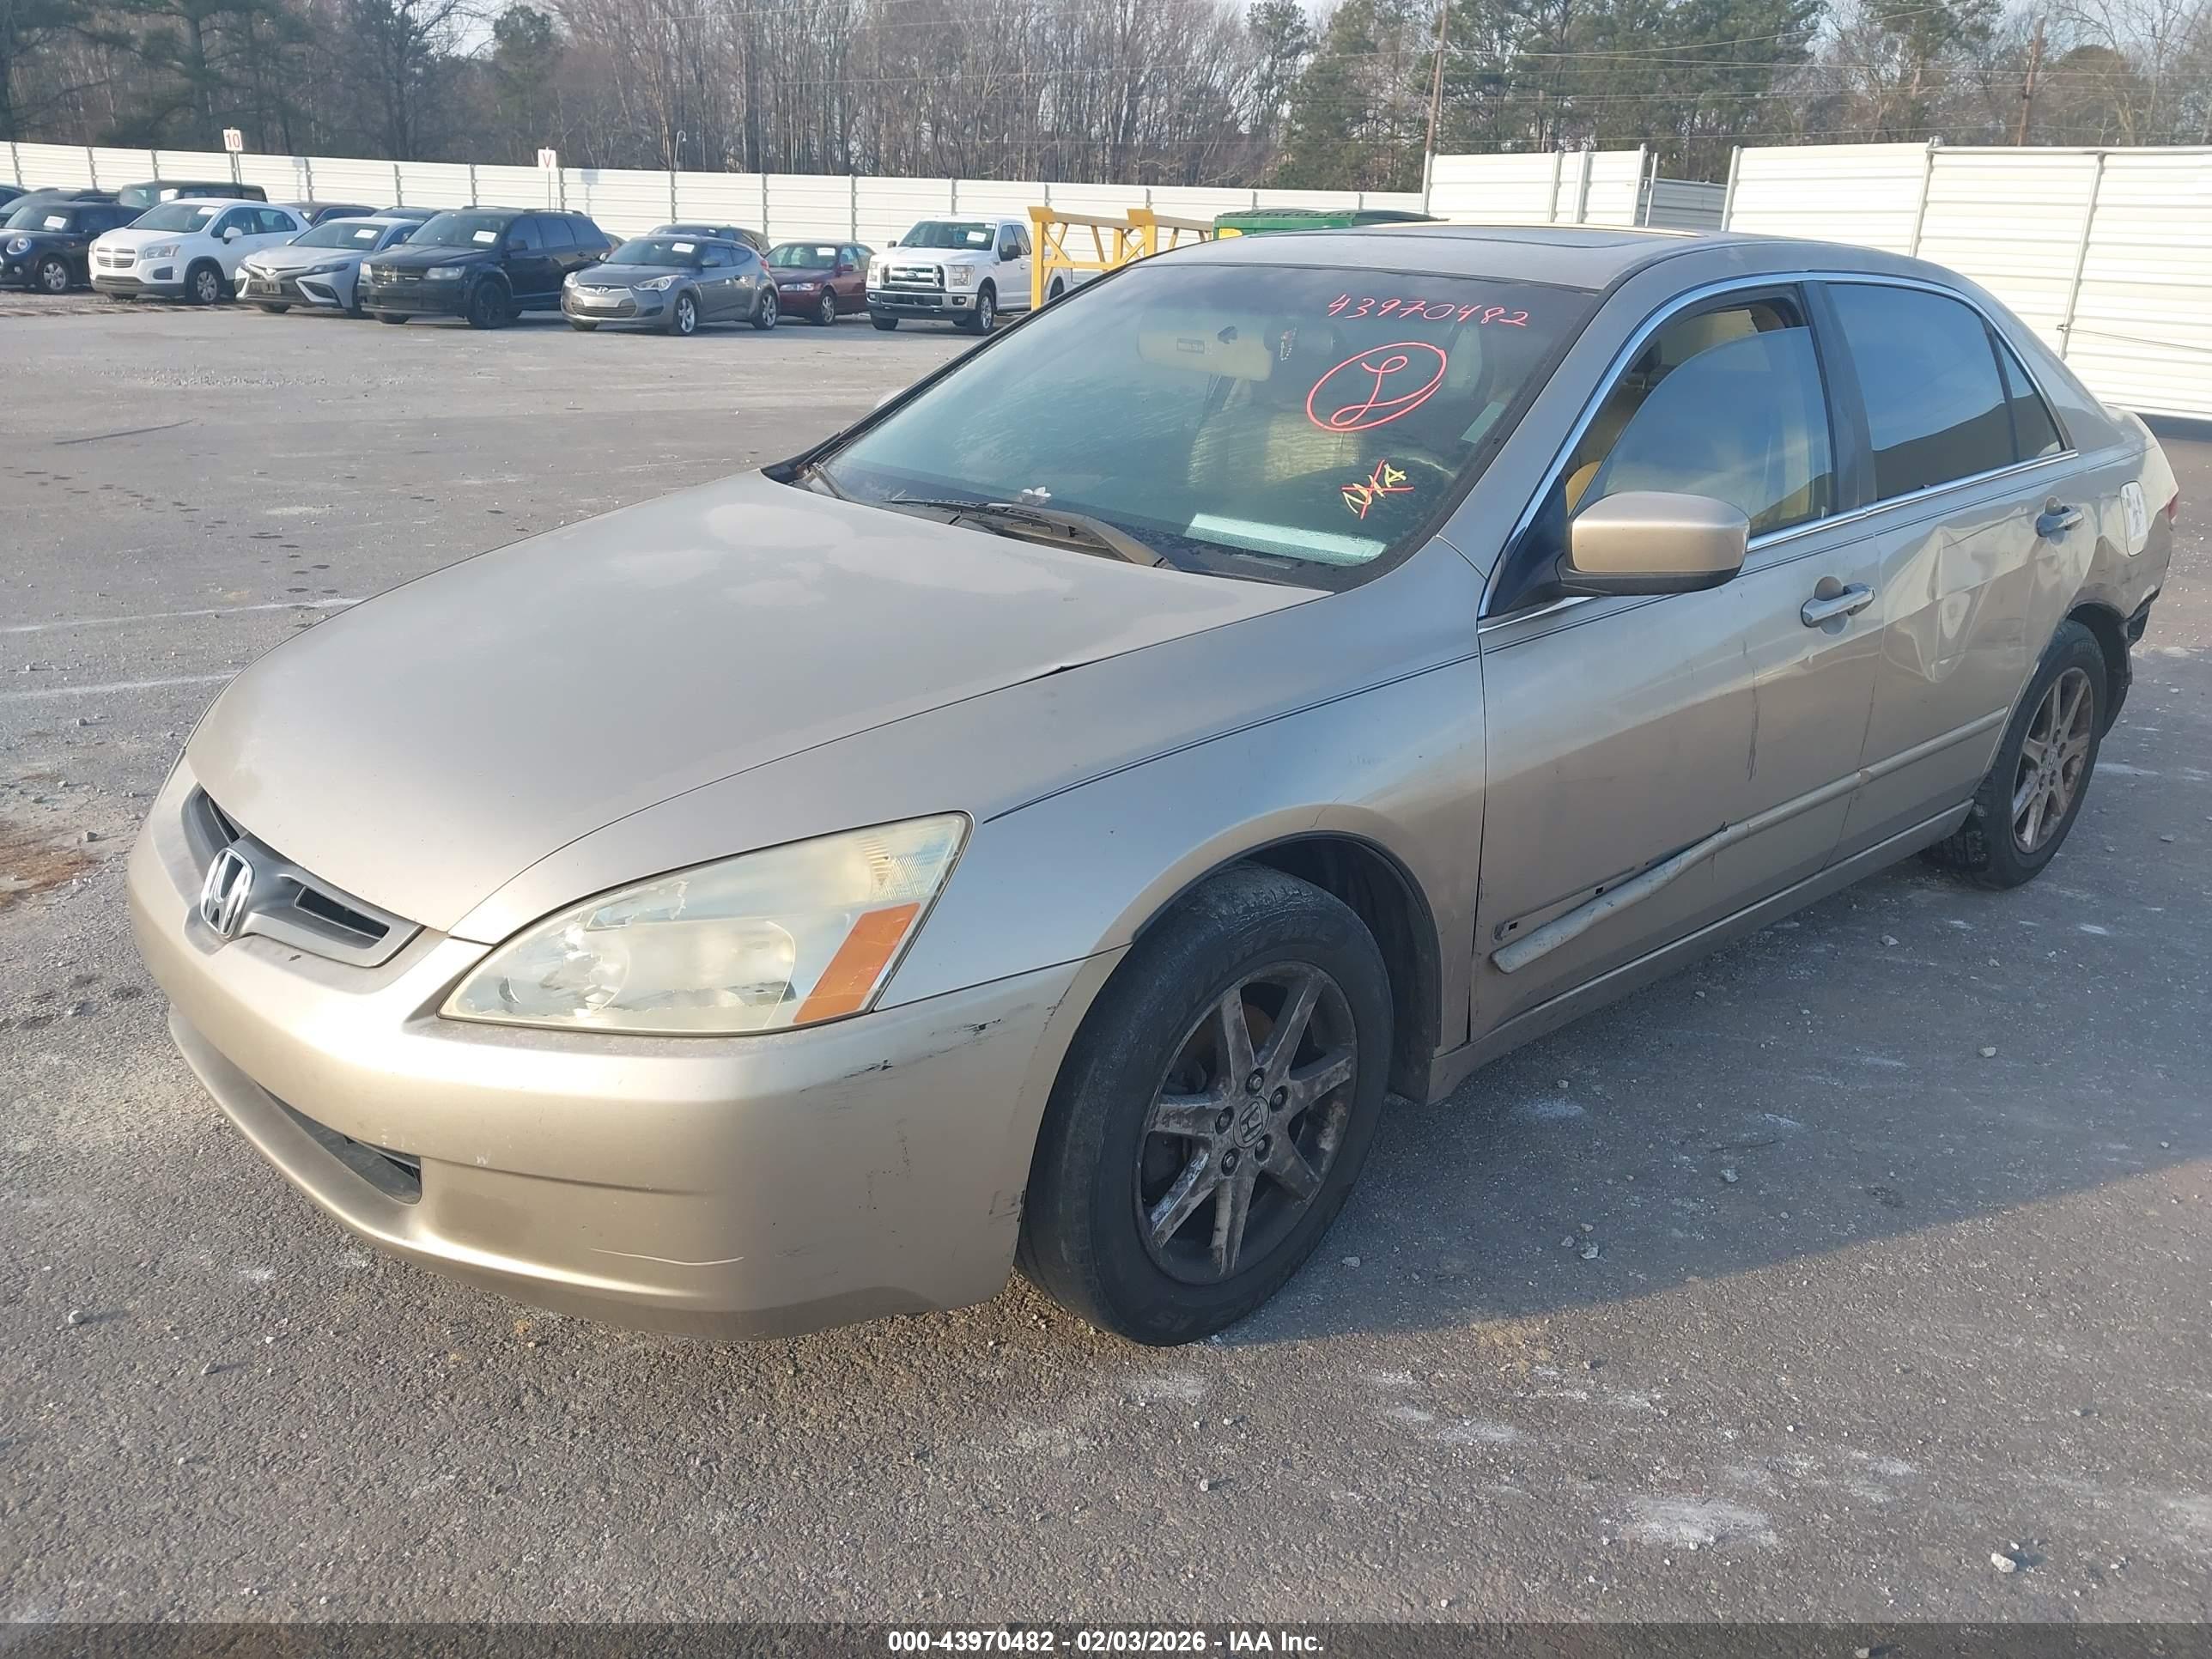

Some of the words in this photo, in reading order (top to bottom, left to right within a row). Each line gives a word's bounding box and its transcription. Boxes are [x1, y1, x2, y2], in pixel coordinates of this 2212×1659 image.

[225, 132, 240, 148] 10
[542, 152, 553, 168] V
[1328, 294, 1529, 326] 43970482
